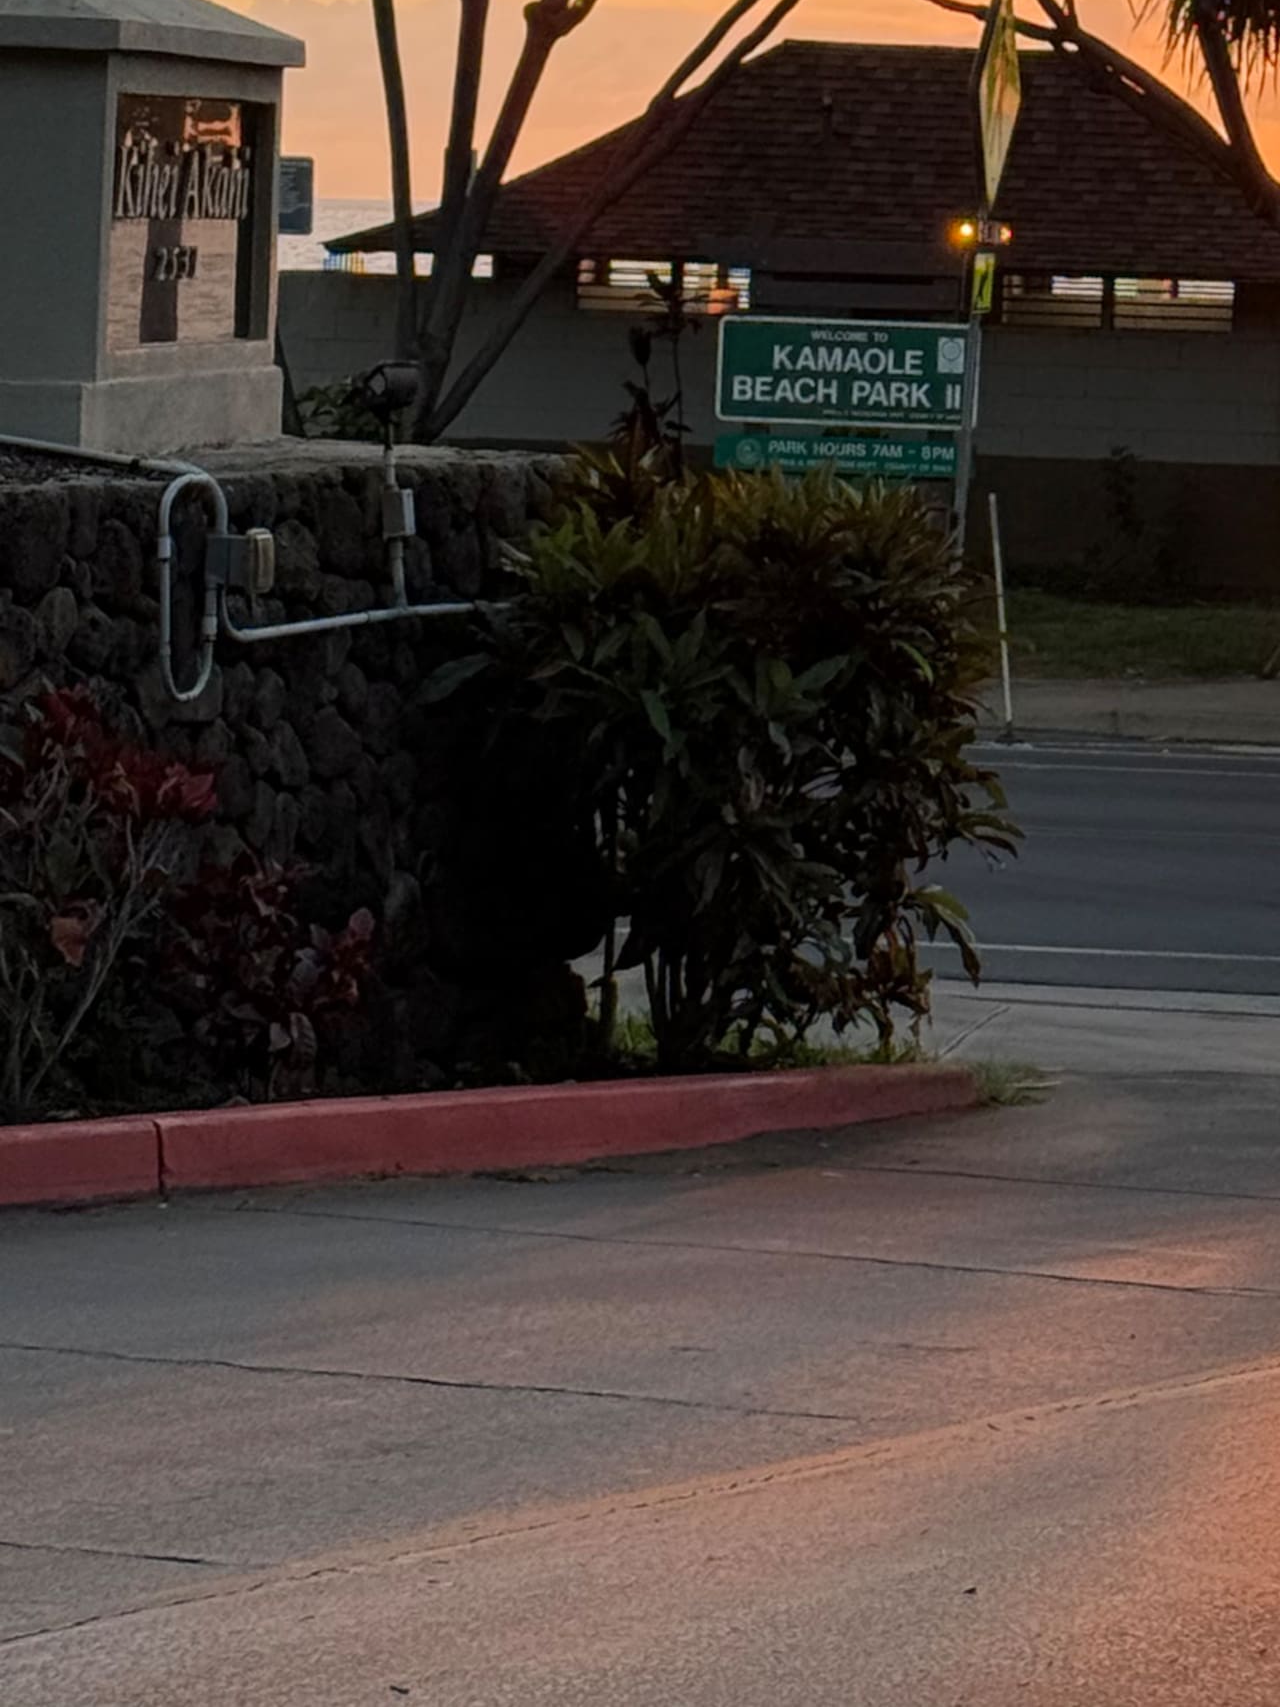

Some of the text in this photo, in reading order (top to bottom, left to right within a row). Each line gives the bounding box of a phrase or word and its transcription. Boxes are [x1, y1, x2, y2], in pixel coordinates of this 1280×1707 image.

[115, 142, 179, 219] Kihei
[811, 329, 889, 343] WELCOME TO
[772, 344, 924, 376] KAMAOLE
[731, 375, 961, 410] BEACH PARK II
[768, 439, 808, 455] PARK
[813, 441, 867, 457] HOURS
[872, 444, 903, 458] 7AM
[921, 445, 955, 460] 8PM
